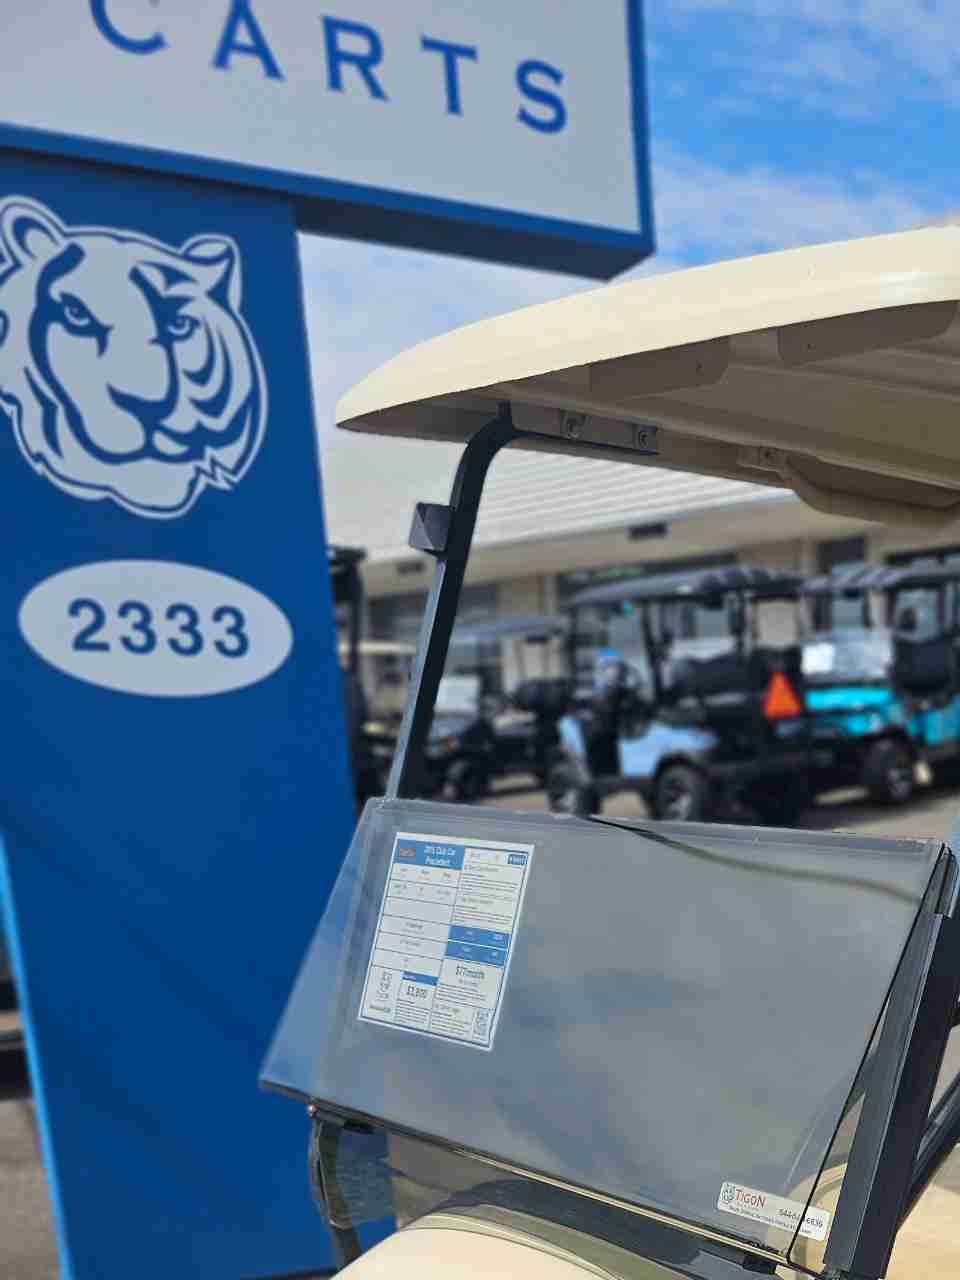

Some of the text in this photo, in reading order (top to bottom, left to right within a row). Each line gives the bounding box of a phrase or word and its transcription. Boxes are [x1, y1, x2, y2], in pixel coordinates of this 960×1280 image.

[89, 0, 568, 134] CARTS
[67, 596, 250, 658] 2333
[735, 1188, 766, 1209] TIGON
